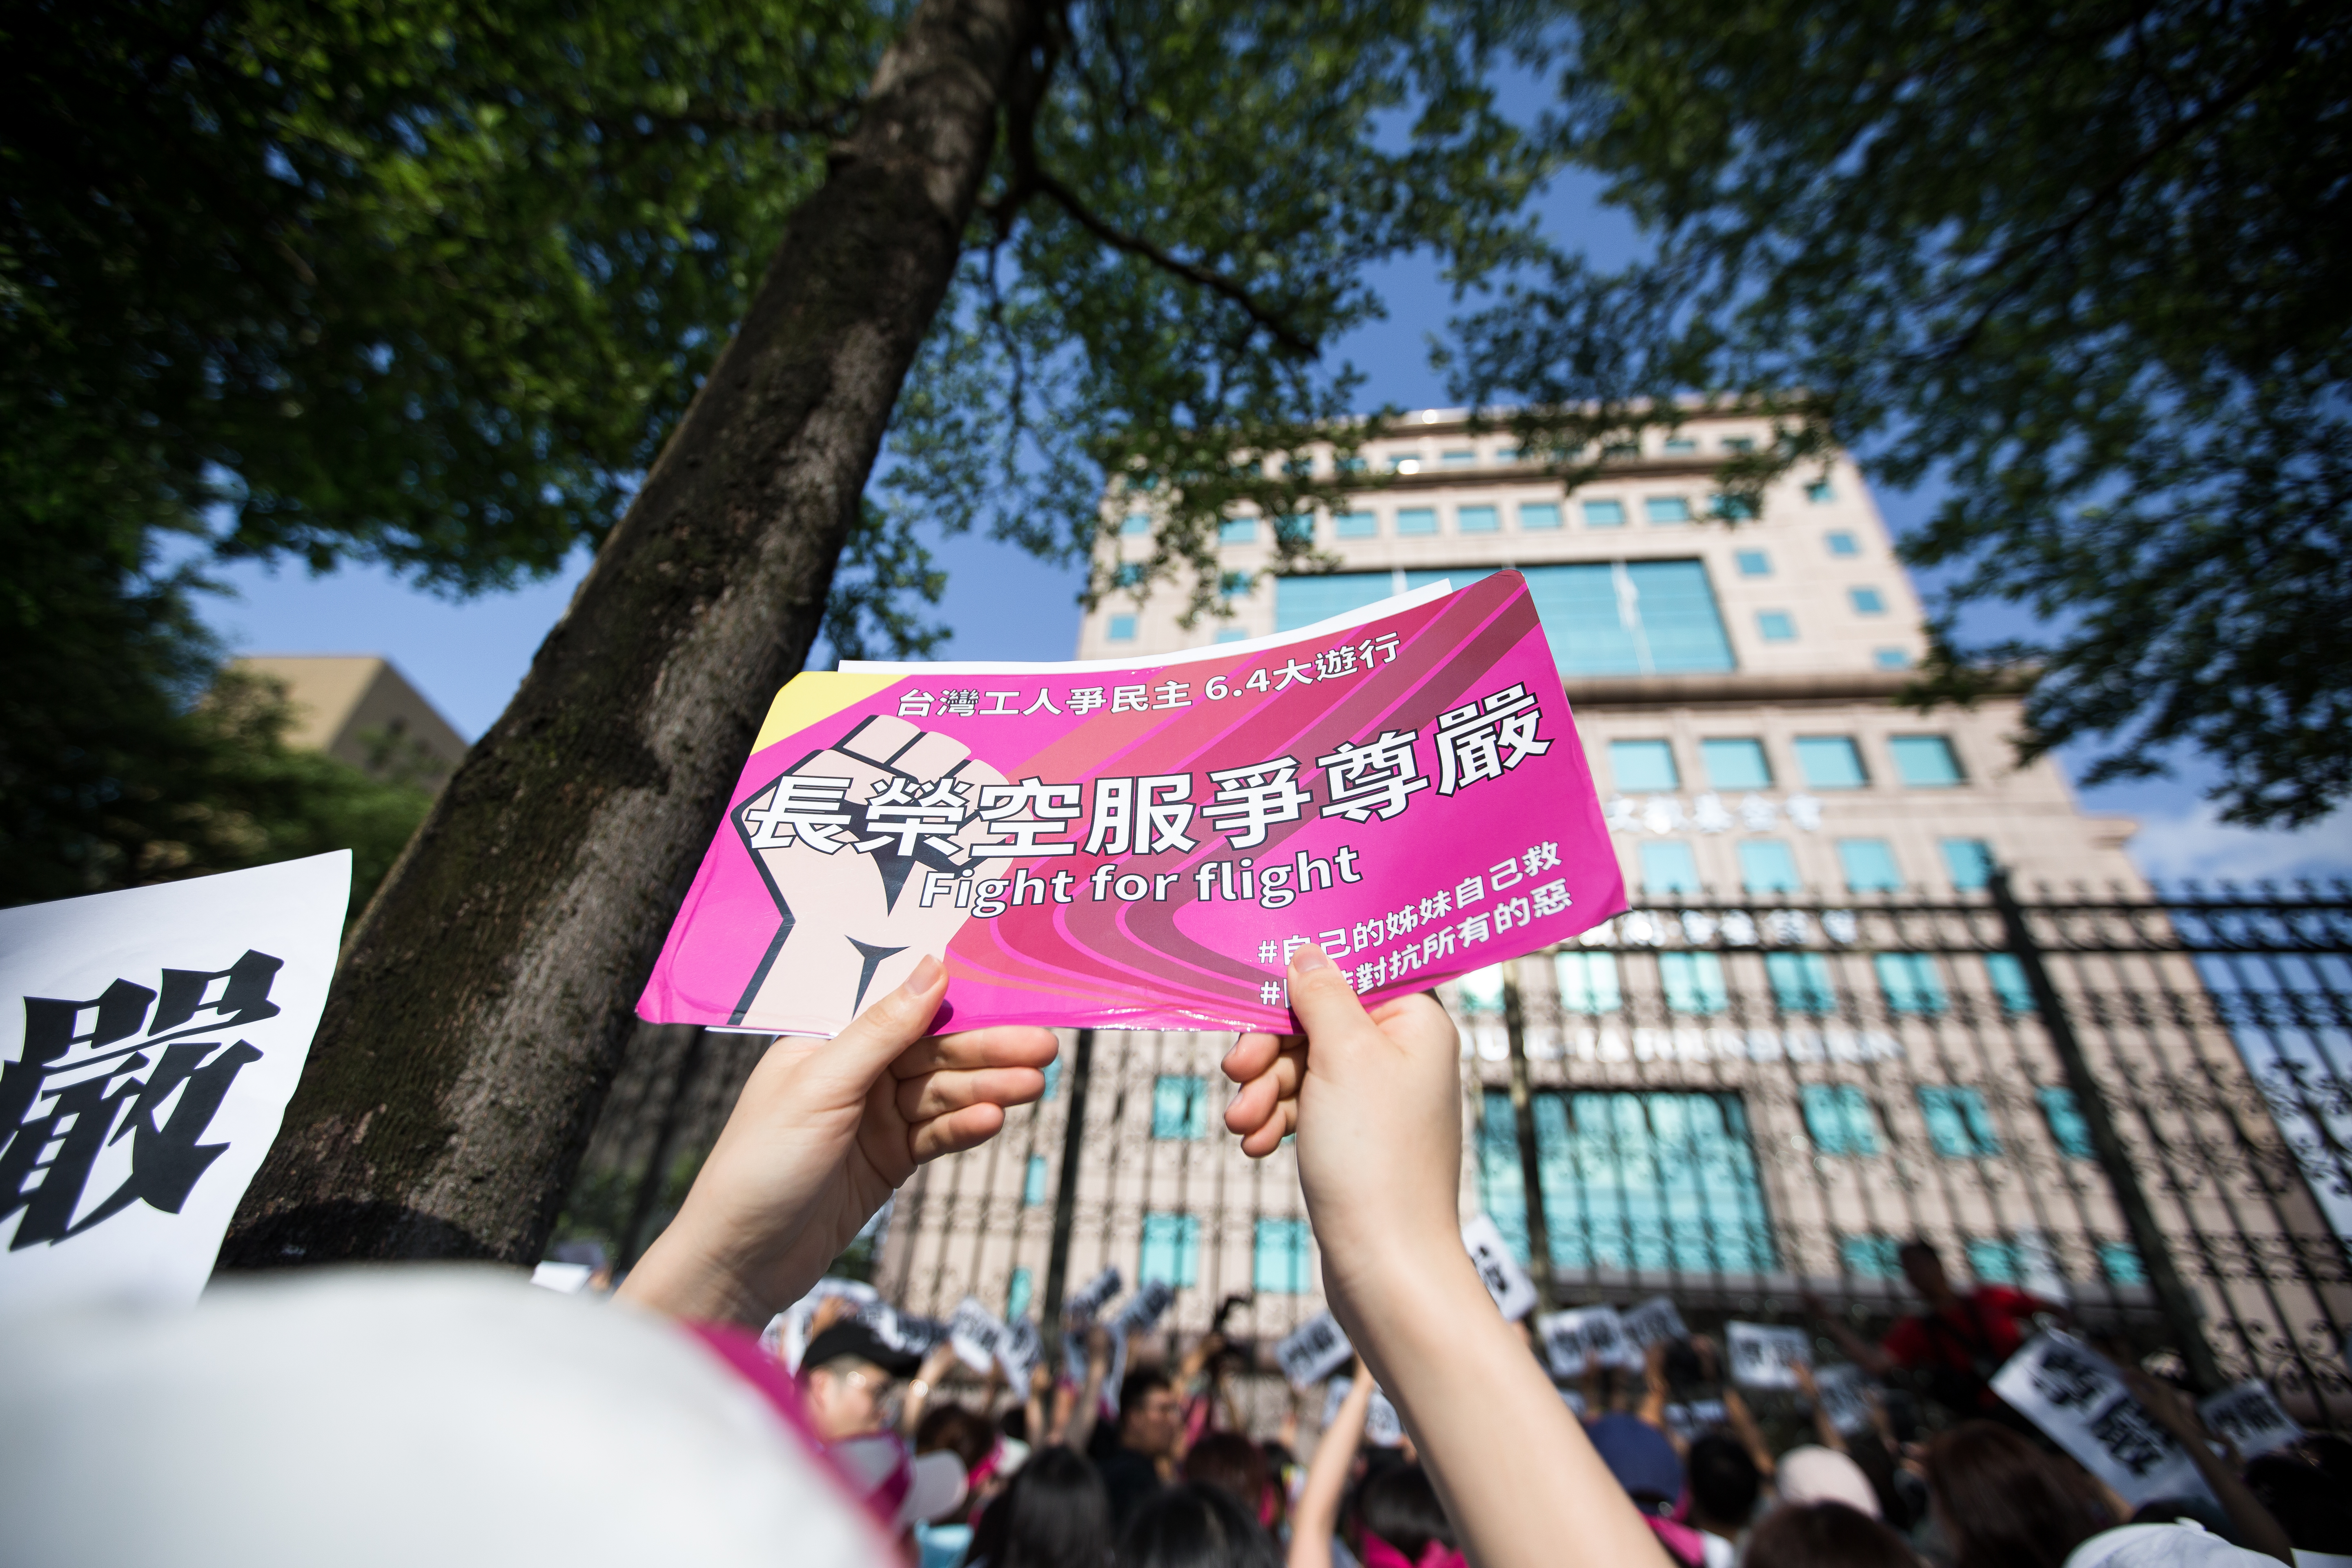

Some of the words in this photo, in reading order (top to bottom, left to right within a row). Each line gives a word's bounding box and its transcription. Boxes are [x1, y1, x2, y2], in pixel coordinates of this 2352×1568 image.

[897, 679, 1193, 717] 台灣工人爭民主
[1204, 631, 1402, 702] 6.4大遊行
[746, 683, 1555, 859] 長榮空服爭尊嚴
[919, 868, 1075, 918] Fight
[1091, 863, 1178, 902] for
[1195, 844, 1362, 909] flight
[1260, 878, 1573, 1008] #對抗所有的惡
[0, 949, 284, 1252] 嚴
